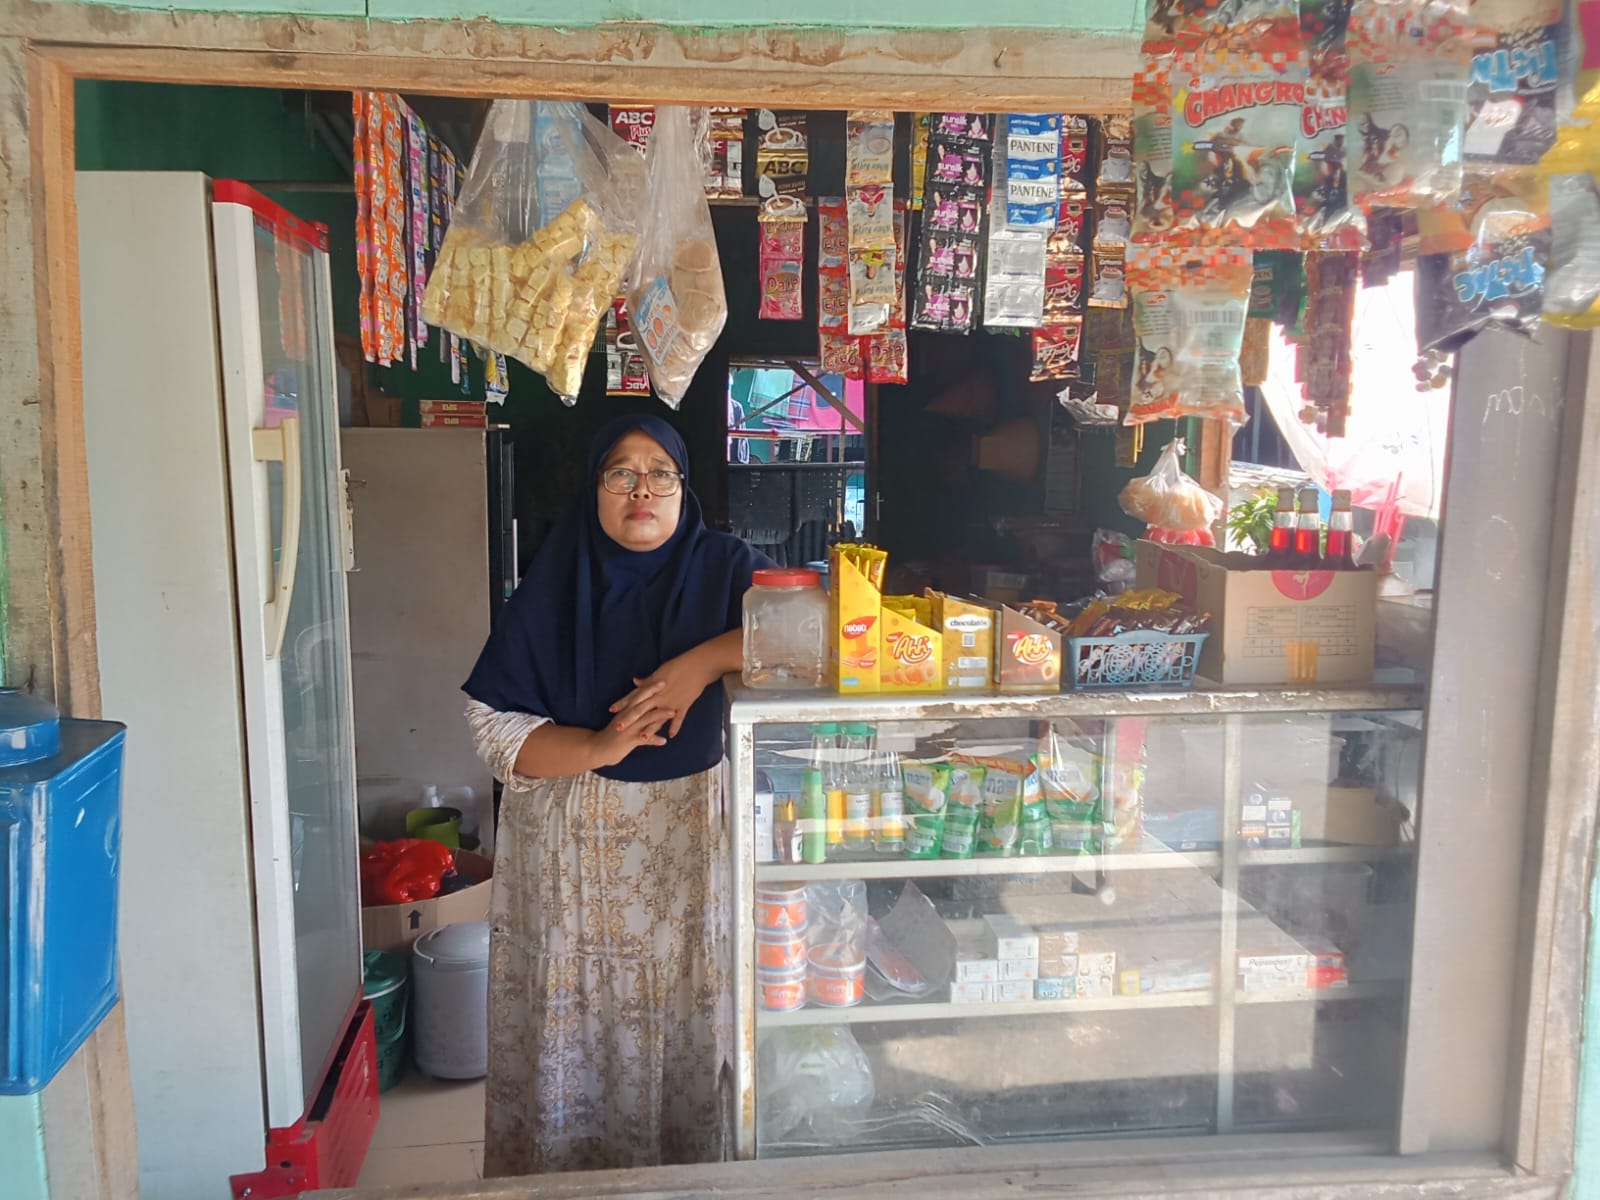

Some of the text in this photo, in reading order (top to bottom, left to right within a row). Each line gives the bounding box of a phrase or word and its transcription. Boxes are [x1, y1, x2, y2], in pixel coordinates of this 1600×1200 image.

[615, 112, 652, 124] ABC
[942, 115, 967, 126] sunsilk
[1010, 140, 1055, 153] PANTENE
[763, 160, 803, 174] ABC
[937, 162, 963, 173] sunsilk
[1010, 185, 1055, 199] PANTENE
[950, 618, 988, 627] chocolatos
